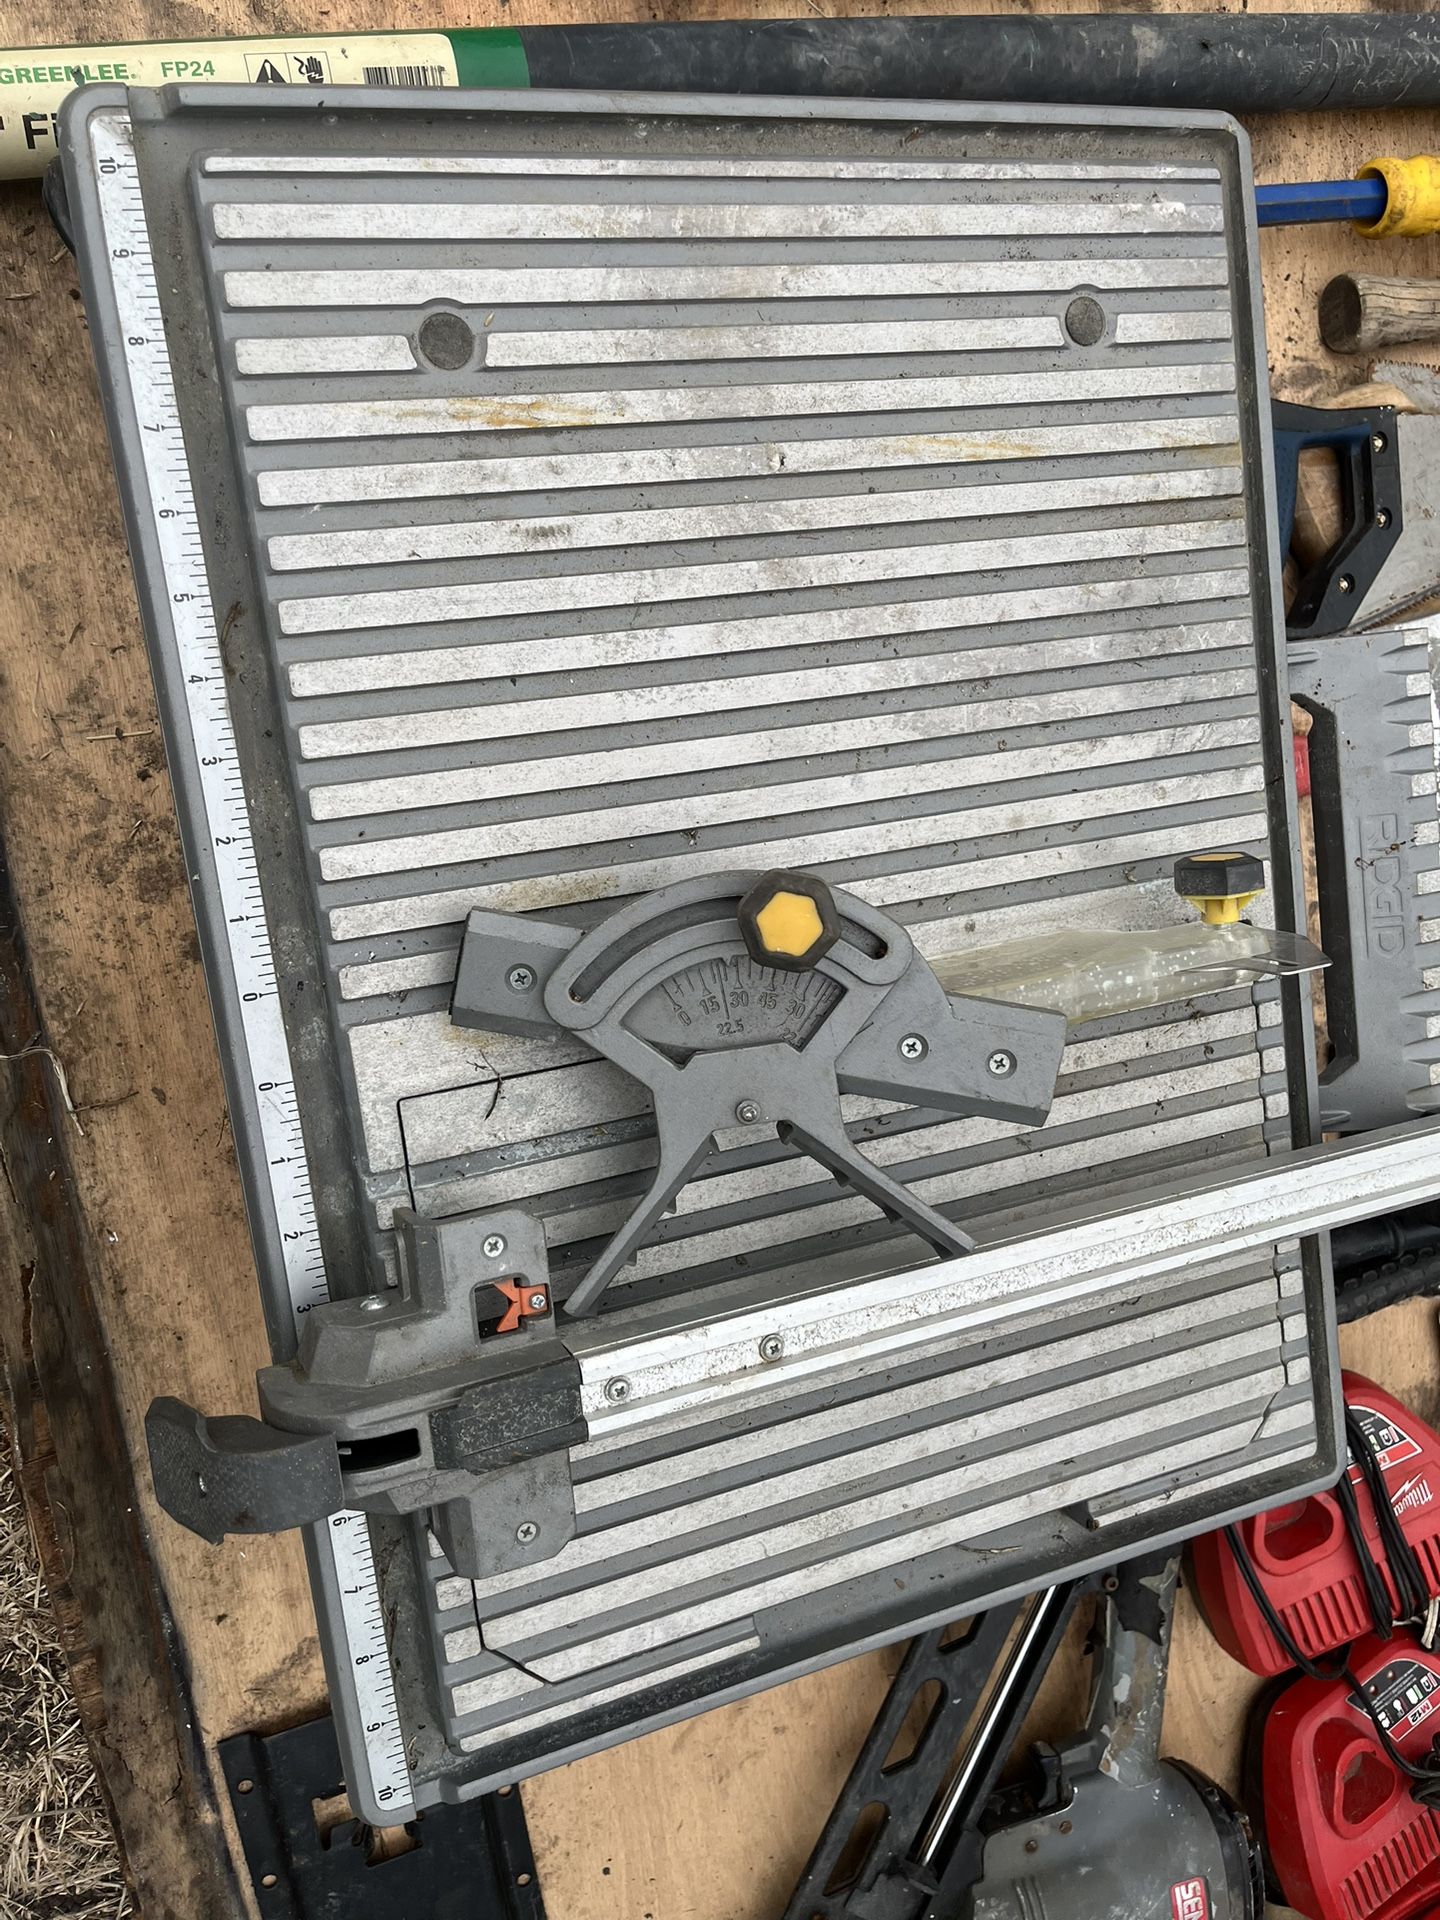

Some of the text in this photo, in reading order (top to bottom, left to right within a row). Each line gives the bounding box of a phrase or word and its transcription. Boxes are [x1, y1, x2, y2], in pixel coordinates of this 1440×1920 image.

[160, 60, 216, 78] FP24
[99, 156, 117, 175] 10
[112, 248, 130, 259] 9
[128, 336, 145, 346] 8
[143, 423, 160, 433] 7
[158, 509, 175, 519] 6
[174, 593, 190, 603] 5
[188, 674, 203, 684] 4
[201, 757, 217, 766] 3
[216, 837, 231, 846] 2
[1367, 813, 1406, 958] RIDGID
[229, 915, 245, 923] 1
[242, 992, 258, 1002] 0
[700, 995, 720, 1015] 15
[730, 991, 749, 1008] 30
[760, 992, 778, 1009] 45
[785, 999, 805, 1019] 30
[716, 1018, 744, 1036] 22.5
[258, 1082, 274, 1092] 0
[270, 1157, 286, 1165] 1
[284, 1231, 299, 1242] 2
[297, 1303, 311, 1314] 3
[333, 1516, 347, 1527] 6
[344, 1586, 358, 1594] 7
[355, 1655, 370, 1665] 8
[1411, 1702, 1430, 1723] M12
[367, 1722, 381, 1733] 9
[378, 1785, 393, 1801] 10
